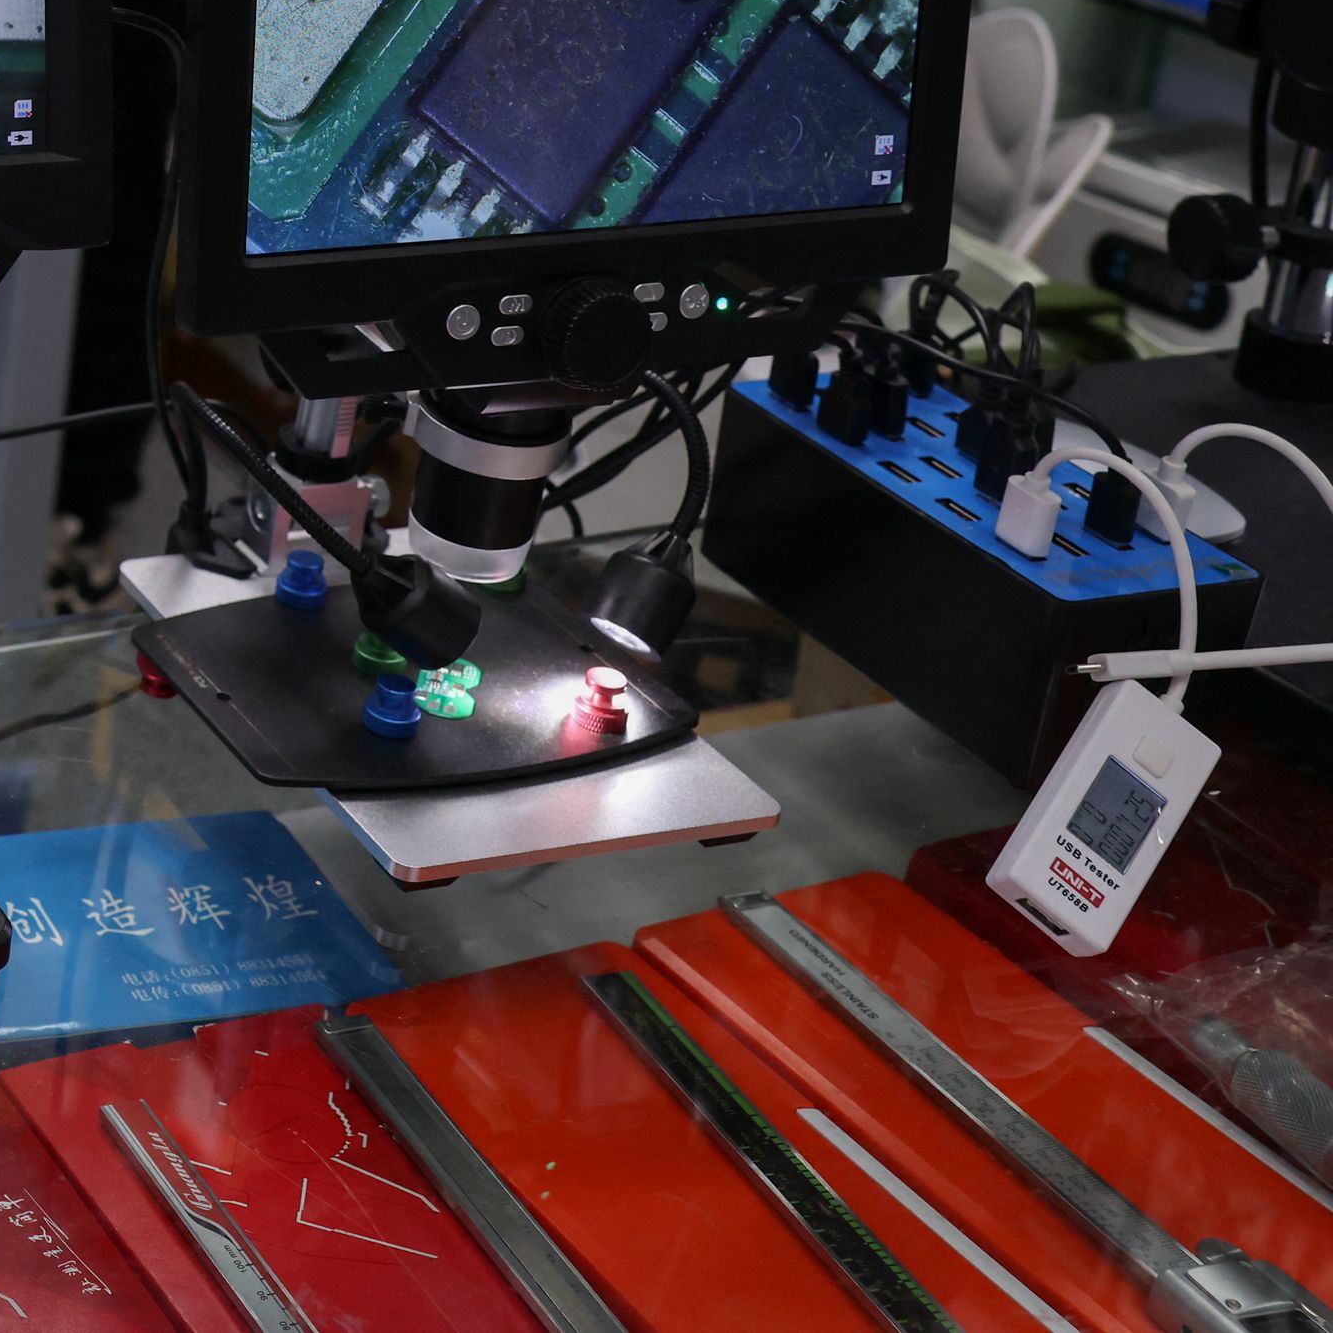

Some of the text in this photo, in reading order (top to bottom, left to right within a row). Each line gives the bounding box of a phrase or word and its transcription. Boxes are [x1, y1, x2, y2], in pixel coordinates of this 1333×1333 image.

[1052, 860, 1103, 903] UNI-T
[1056, 835, 1121, 891] USB Tester
[5, 874, 320, 947] 创造辉煌
[1047, 876, 1089, 914] UT658B
[821, 970, 880, 1020] STAINLESS
[233, 1258, 248, 1274] 100
